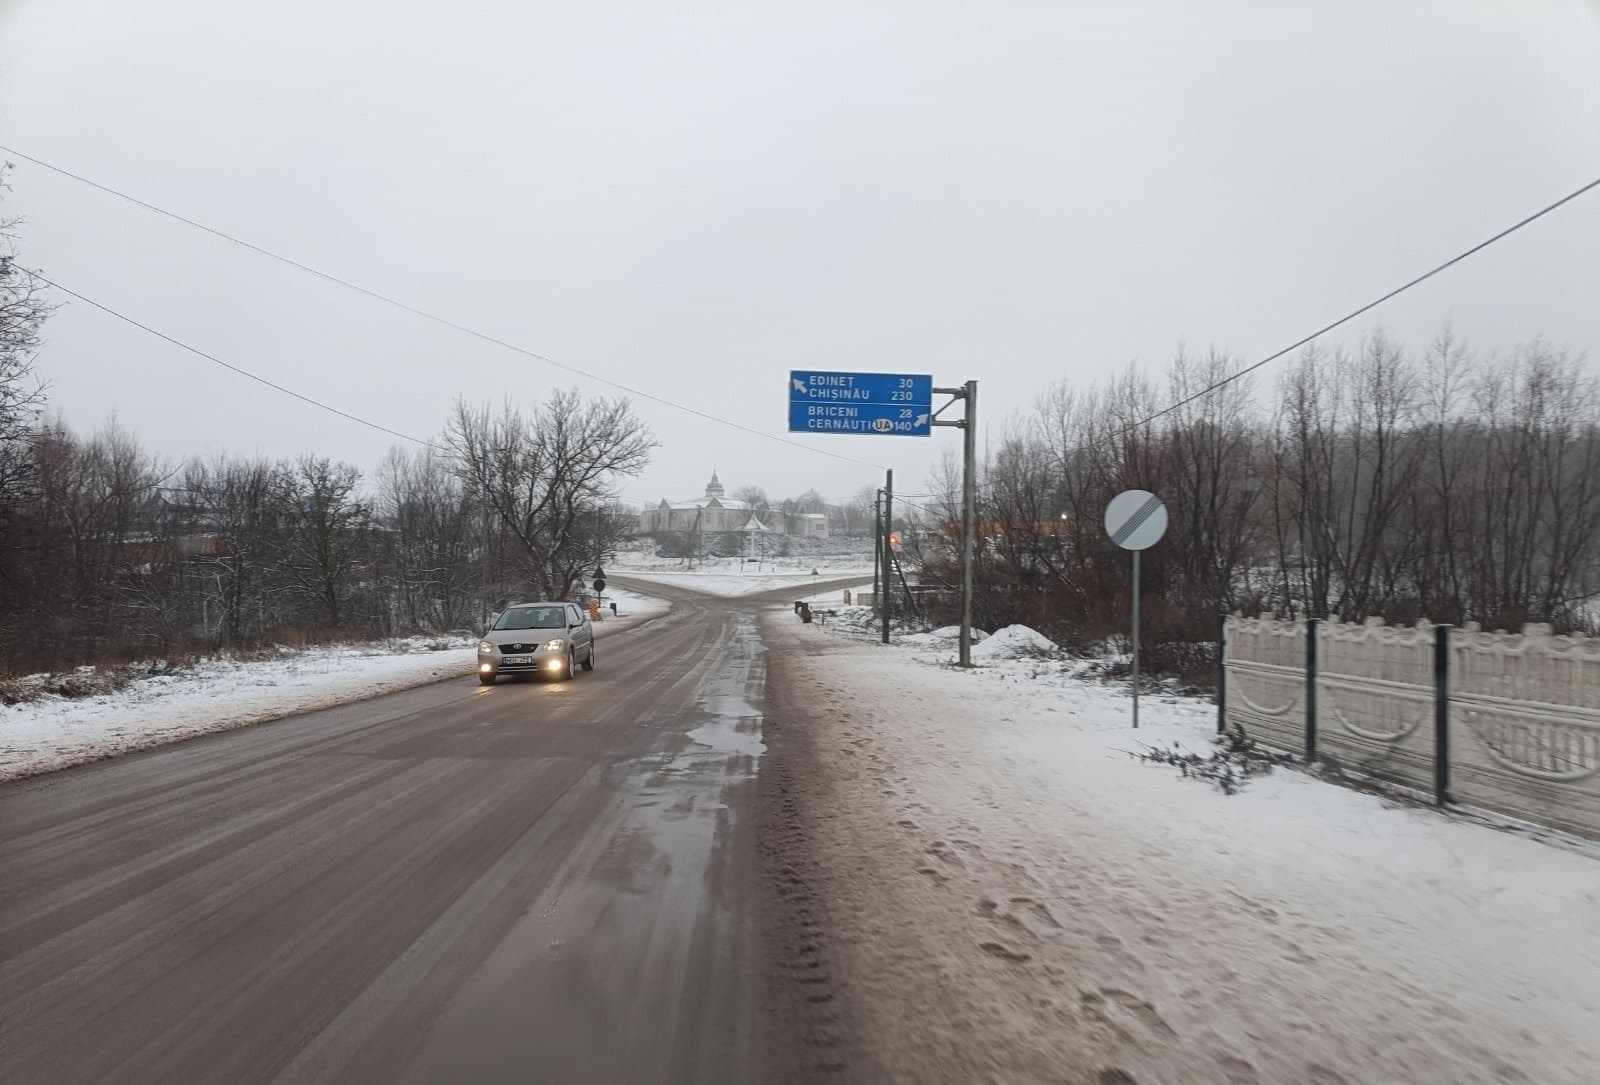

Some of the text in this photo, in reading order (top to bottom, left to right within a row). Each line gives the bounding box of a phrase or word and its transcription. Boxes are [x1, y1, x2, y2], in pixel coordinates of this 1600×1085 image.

[898, 378, 914, 389] 30
[891, 391, 913, 401] 230
[808, 406, 913, 419] BRICENI 28
[874, 420, 891, 431] UA
[894, 421, 912, 432] 140
